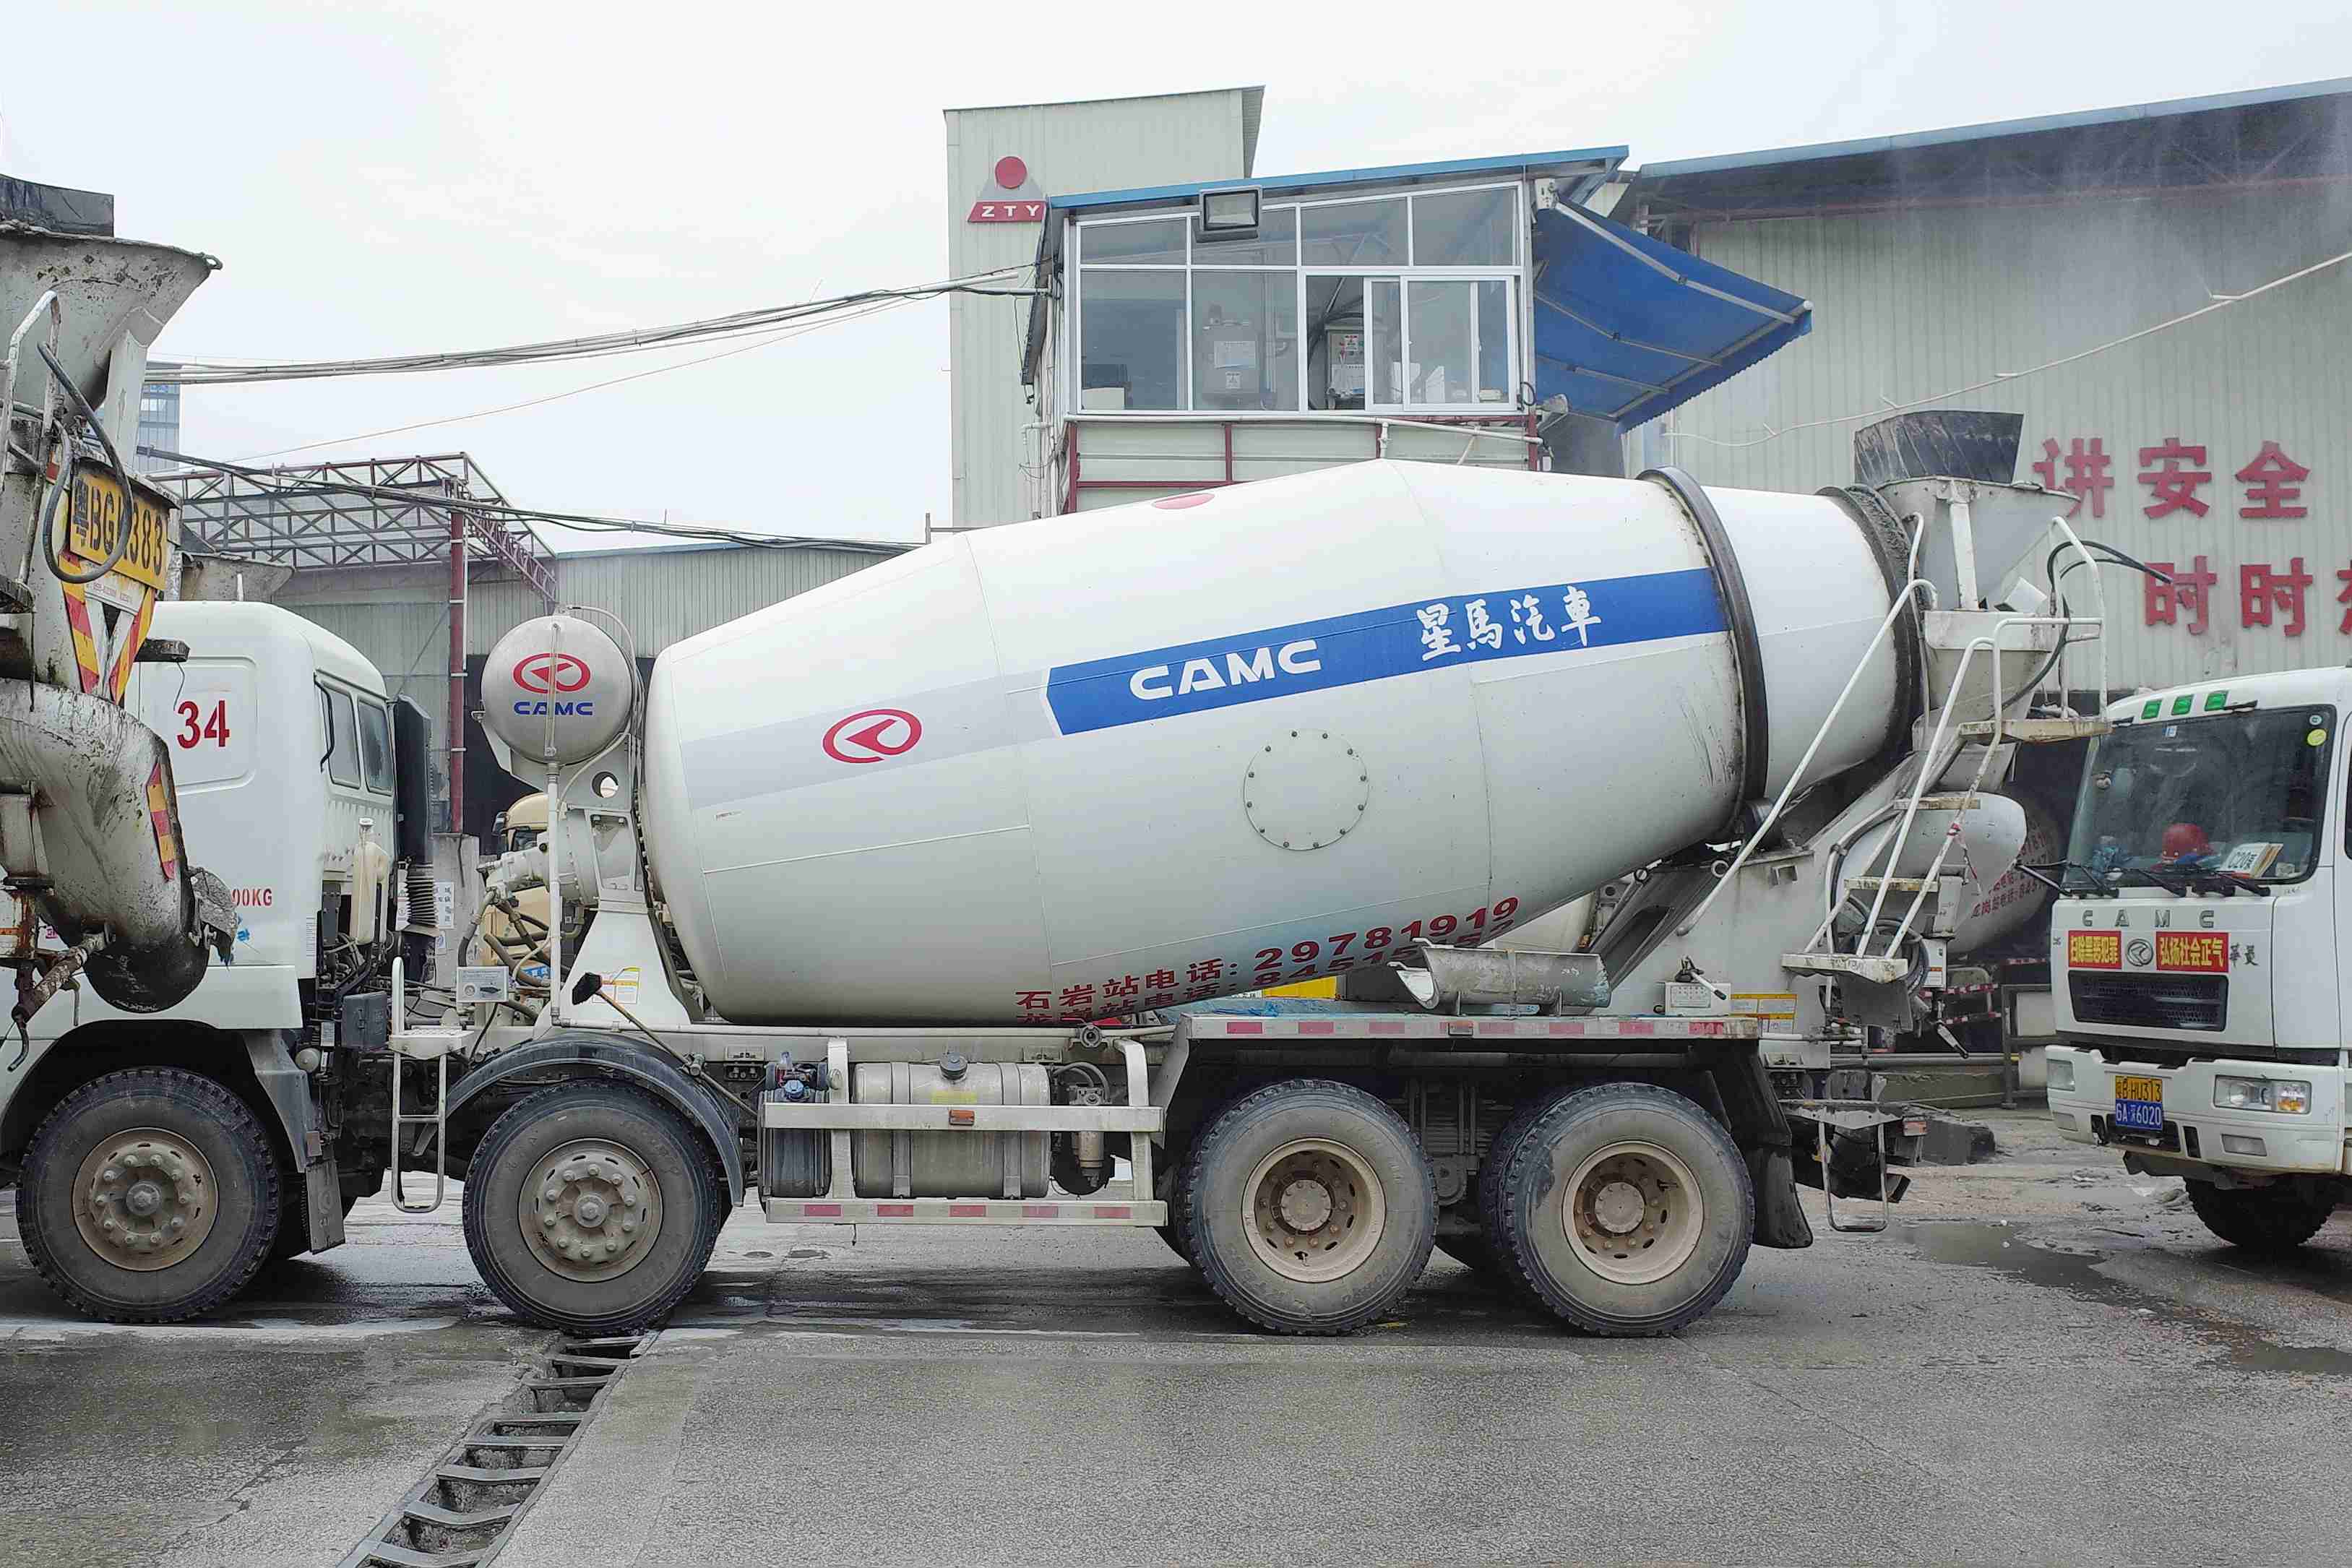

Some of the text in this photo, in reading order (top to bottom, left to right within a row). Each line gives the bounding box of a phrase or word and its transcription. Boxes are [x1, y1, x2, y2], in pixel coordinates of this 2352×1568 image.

[981, 204, 1041, 218] ZTY
[2033, 437, 2311, 518] 讲安全
[1129, 639, 1322, 700] CAMC
[176, 699, 230, 749] 34
[514, 701, 594, 716] CAMC
[2082, 910, 2215, 929] CAMC
[2159, 936, 2225, 968] 弘扬社会正气
